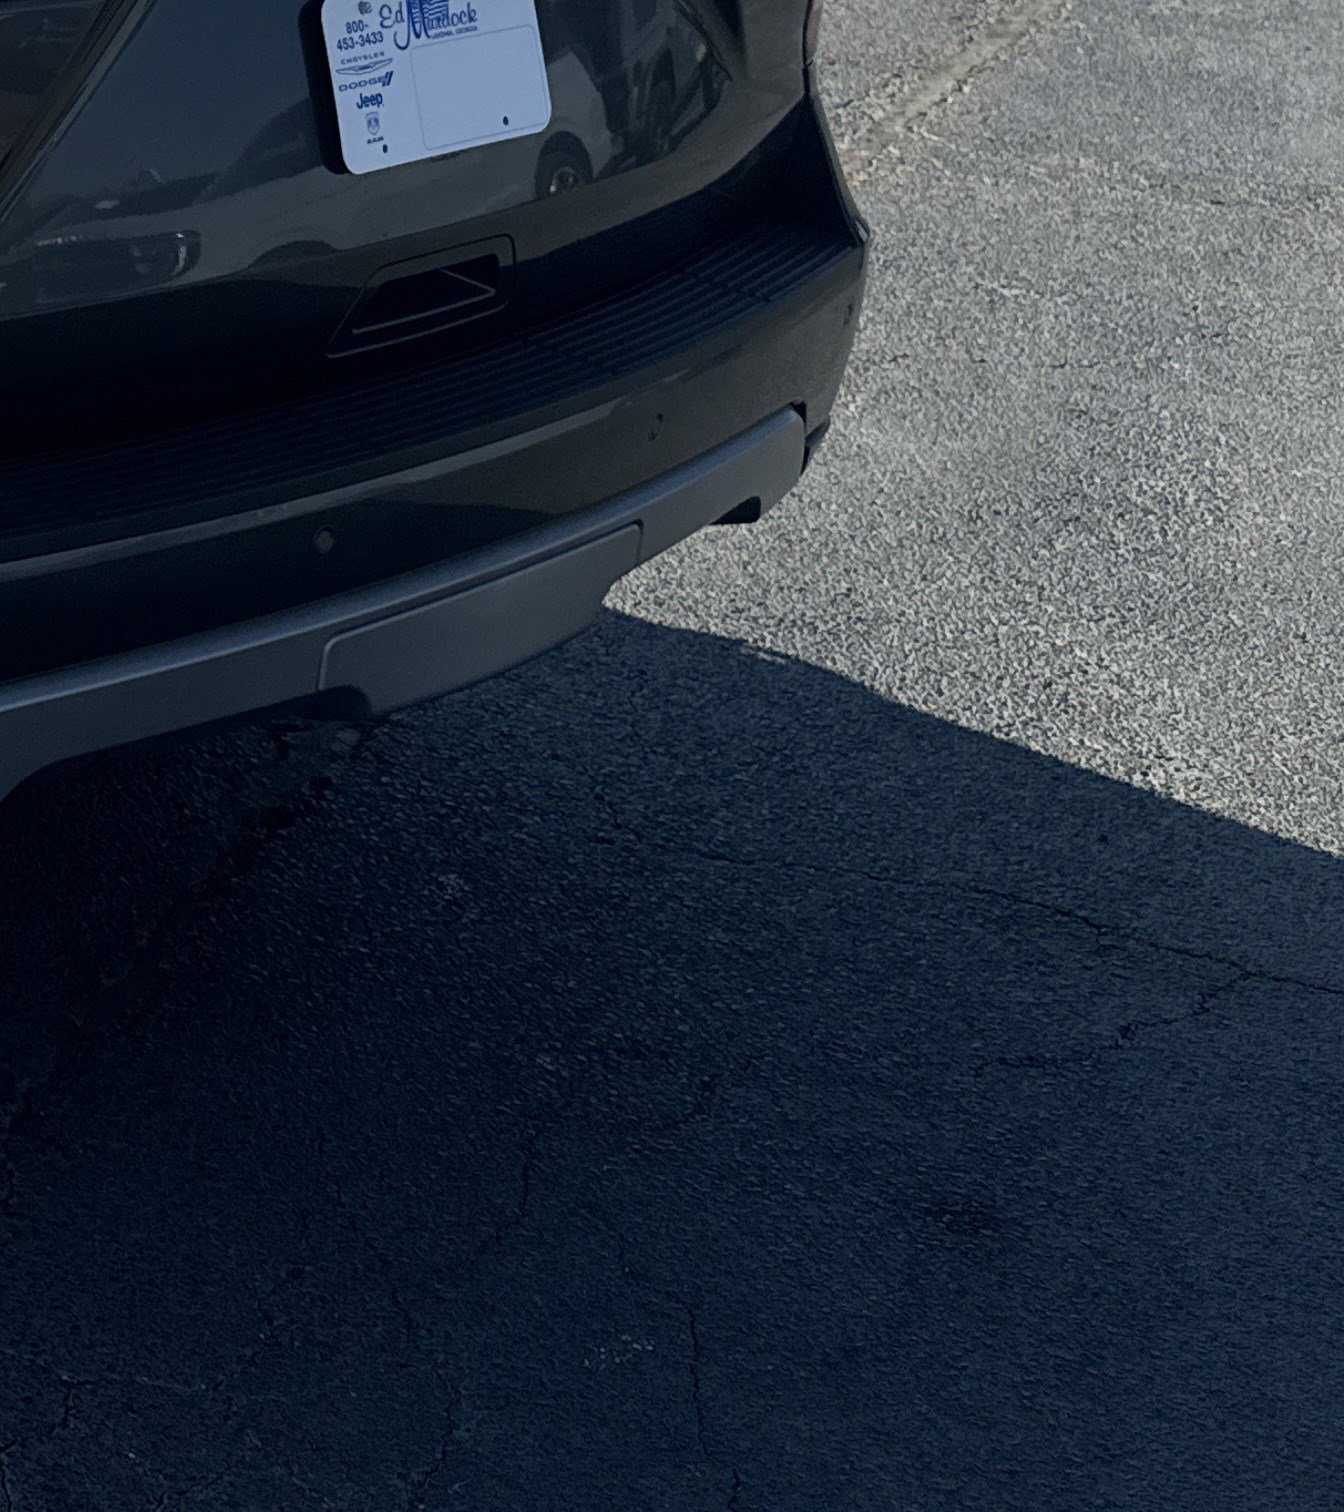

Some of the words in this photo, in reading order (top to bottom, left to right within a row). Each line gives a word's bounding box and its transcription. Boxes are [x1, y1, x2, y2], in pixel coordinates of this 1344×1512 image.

[379, 1, 406, 29] Ed
[345, 19, 369, 34] 800-
[337, 31, 384, 51] 453-3433
[340, 51, 385, 65] CHRYSLER
[338, 75, 386, 92] DODGE
[356, 92, 383, 110] Jeep
